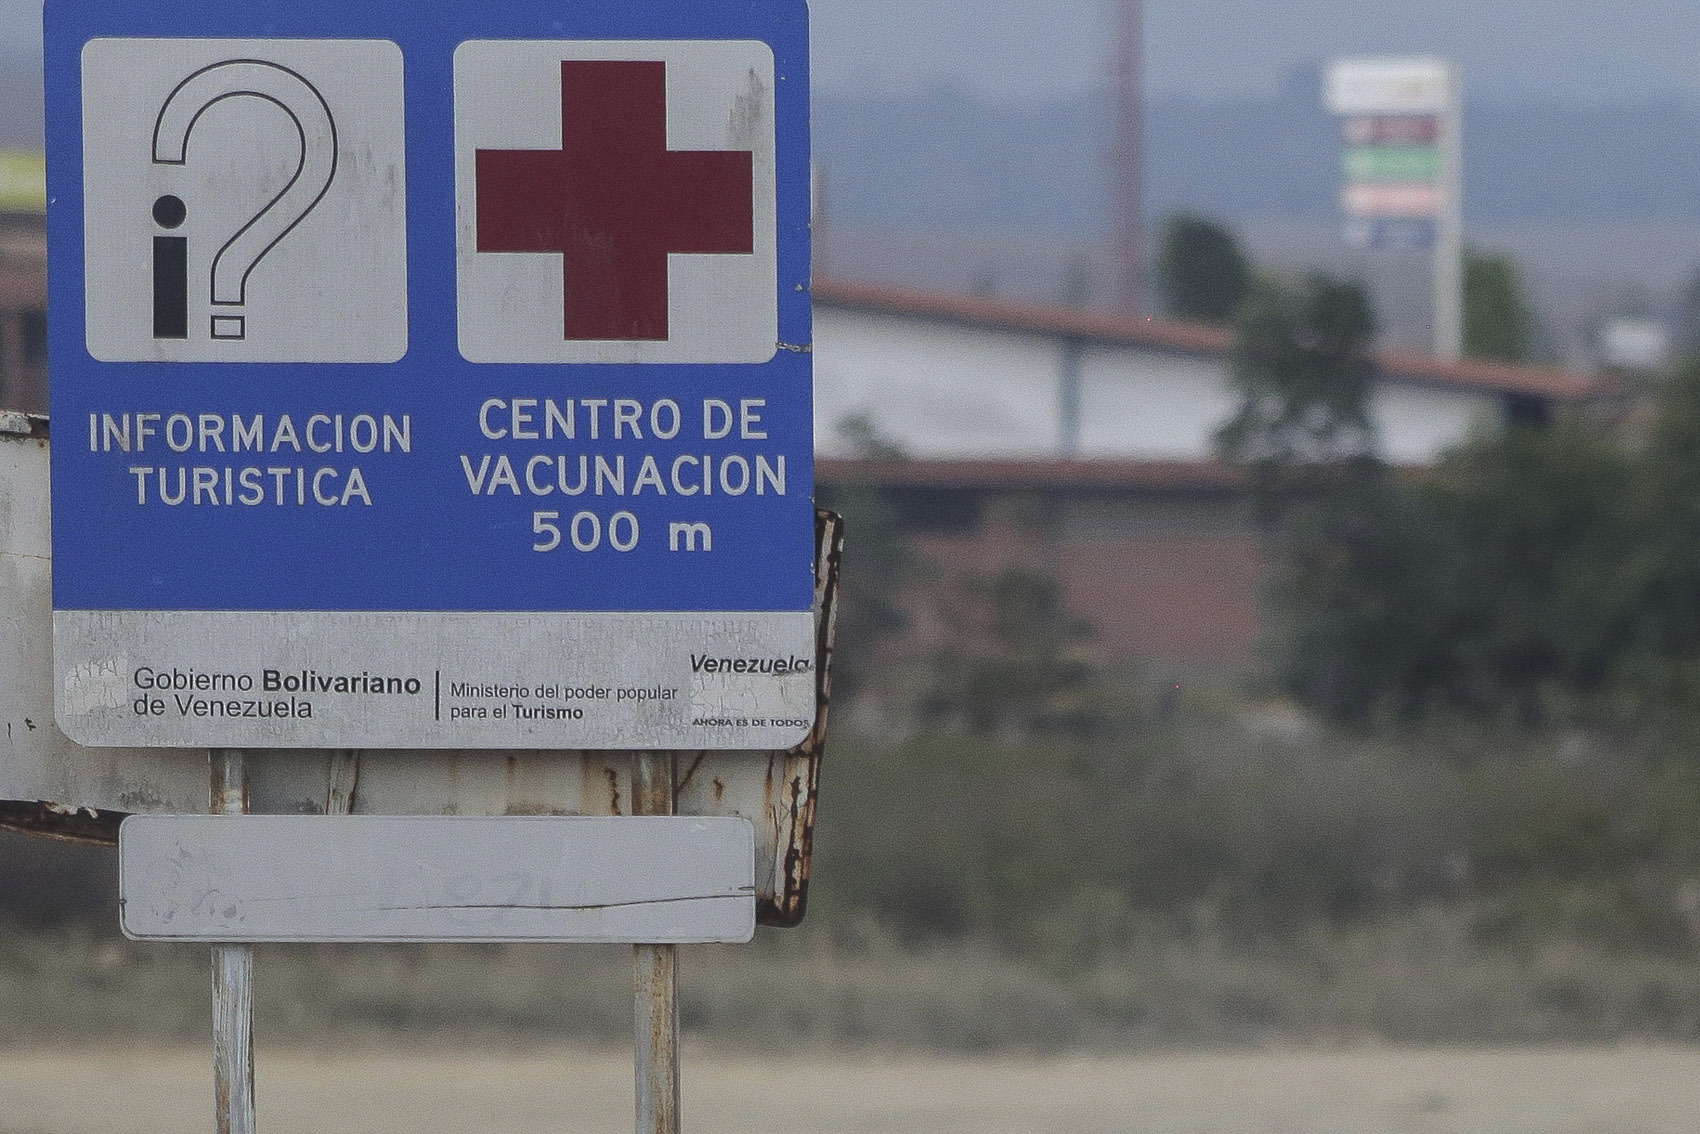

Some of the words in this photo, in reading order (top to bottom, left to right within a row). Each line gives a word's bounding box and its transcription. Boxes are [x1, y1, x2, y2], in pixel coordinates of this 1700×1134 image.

[90, 413, 411, 453] INFORMACION
[479, 399, 681, 440] CENTRO
[703, 399, 768, 439] DE
[129, 467, 372, 506] TURISTICA
[460, 455, 787, 496] VACUNACION
[532, 511, 639, 552] 500
[669, 522, 713, 551] m
[690, 654, 811, 674] Venezuela
[133, 666, 253, 691] Gobierno
[262, 669, 421, 694] Bolivariano
[450, 682, 530, 698] Ministerio
[535, 684, 560, 698] del
[565, 685, 612, 701] poder
[617, 685, 678, 702] popular
[133, 694, 166, 716] de
[174, 694, 313, 718] Venezuela
[450, 706, 488, 721] para
[492, 705, 507, 719] el
[512, 704, 584, 720] Turismo
[692, 718, 733, 727] AHORA
[736, 718, 749, 727] ES
[751, 718, 767, 727] DE
[770, 718, 809, 727] TODOS
